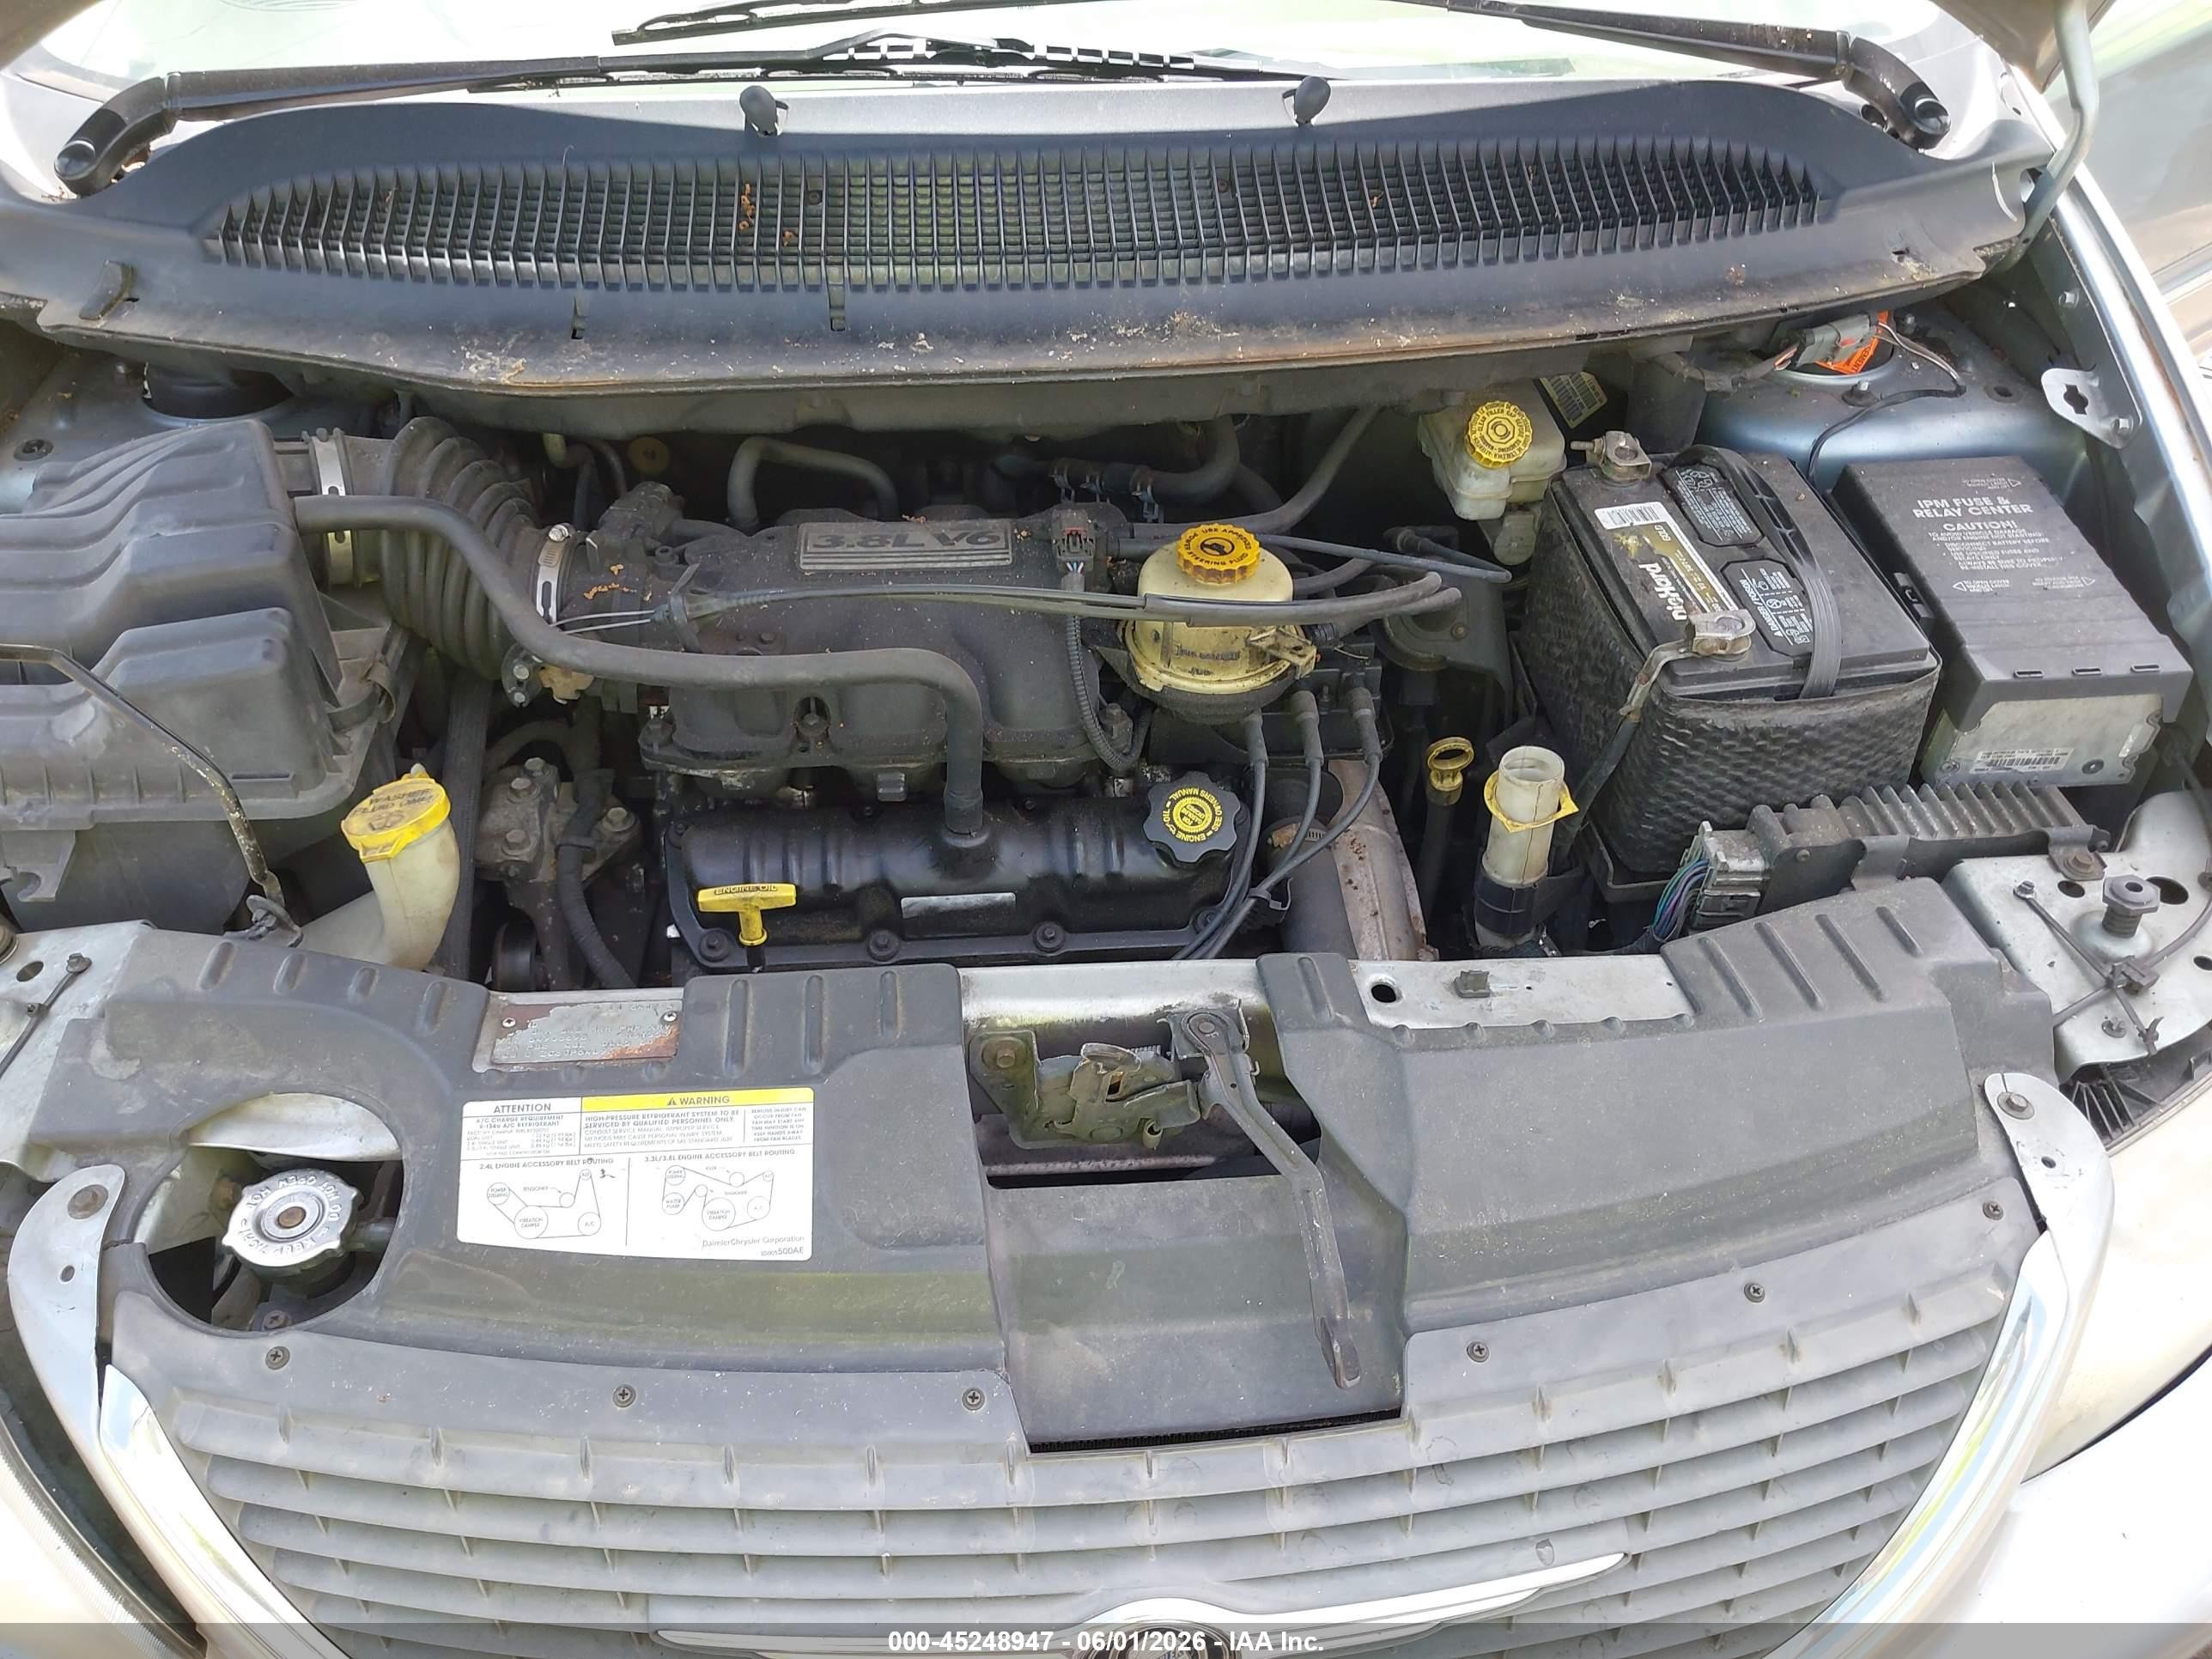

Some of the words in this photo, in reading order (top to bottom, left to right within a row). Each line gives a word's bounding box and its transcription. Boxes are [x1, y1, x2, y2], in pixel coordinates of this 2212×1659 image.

[1917, 499, 1949, 509] IPM
[1953, 496, 1994, 507] FUSE
[1996, 495, 2011, 506] &
[1912, 507, 1964, 519] RELAY
[1967, 504, 2034, 516] CENTER
[1942, 520, 2019, 532] CAUTION!
[812, 532, 925, 549] 3.8L
[933, 531, 1001, 547] V6
[1654, 524, 1673, 543] GOLD
[1638, 562, 1688, 622] DieHard
[1756, 605, 1780, 632] DANGER
[369, 787, 433, 805] WASHER
[1169, 787, 1200, 801] MANUAL
[1162, 809, 1171, 824] OIL
[1211, 816, 1223, 832] SEE
[1175, 831, 1207, 842] ENGINE
[714, 886, 757, 896] ENGINE
[679, 1095, 731, 1106] WARNING
[493, 1103, 552, 1114] ATTENTION
[633, 1118, 670, 1127] QUALIFIED
[678, 1152, 702, 1161] ENGINE
[705, 1151, 746, 1160] ACCESSORY
[764, 1148, 795, 1157] ROUTING
[521, 1160, 564, 1169] ACCESSORY
[582, 1157, 615, 1165] ROUTING
[277, 1175, 318, 1189] OPEN
[246, 1186, 273, 1210] HOT
[702, 1237, 760, 1248] DaimlerChrysler
[762, 1235, 805, 1246] Corporation
